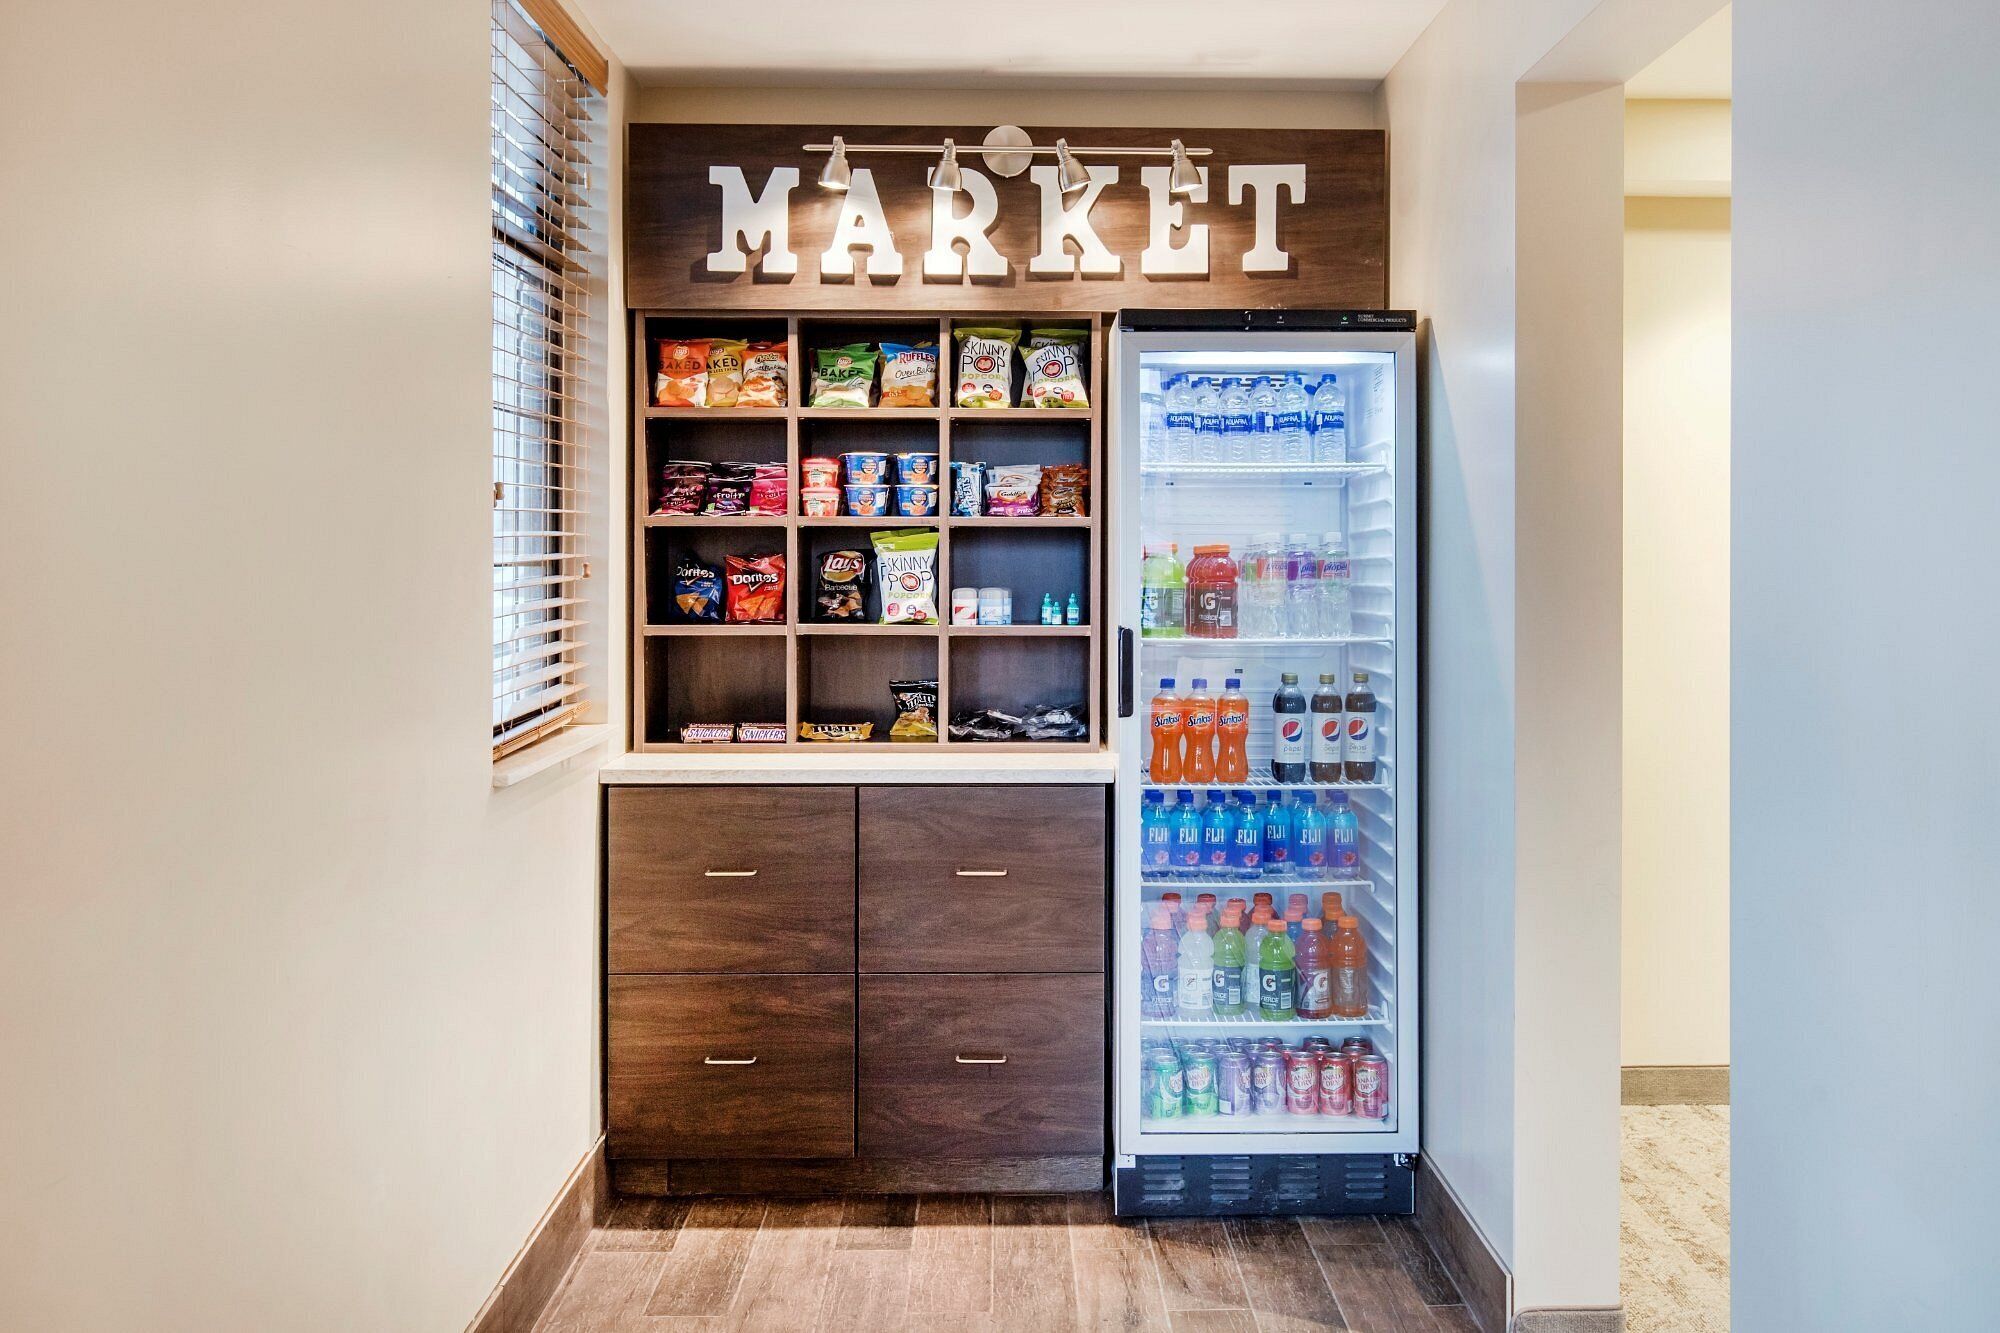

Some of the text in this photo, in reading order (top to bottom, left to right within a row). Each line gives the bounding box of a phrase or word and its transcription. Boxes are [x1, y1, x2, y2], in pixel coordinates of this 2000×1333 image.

[706, 164, 1307, 276] MARKET
[706, 358, 739, 370] AKED
[898, 352, 935, 363] RUFFLES
[961, 355, 1006, 374] POP
[1169, 415, 1194, 424] AQUAFINA
[732, 573, 779, 585] Doritos
[887, 570, 932, 592] POP
[824, 583, 858, 591] Barbecue
[1154, 713, 1181, 728] Sunkist
[1187, 713, 1214, 728] Sunkist
[1218, 713, 1246, 728] Sunkist
[686, 727, 731, 739] SNICKERS
[743, 728, 787, 741] SNICKERS
[1148, 827, 1168, 842] FIJI
[1179, 828, 1199, 843] FIJI
[1205, 827, 1225, 842] FIJI
[1237, 829, 1257, 844] FIJI
[1267, 824, 1286, 839] FIJI
[1301, 829, 1321, 843] FIJI
[1334, 828, 1354, 843] FIJI
[1262, 974, 1277, 992] G
